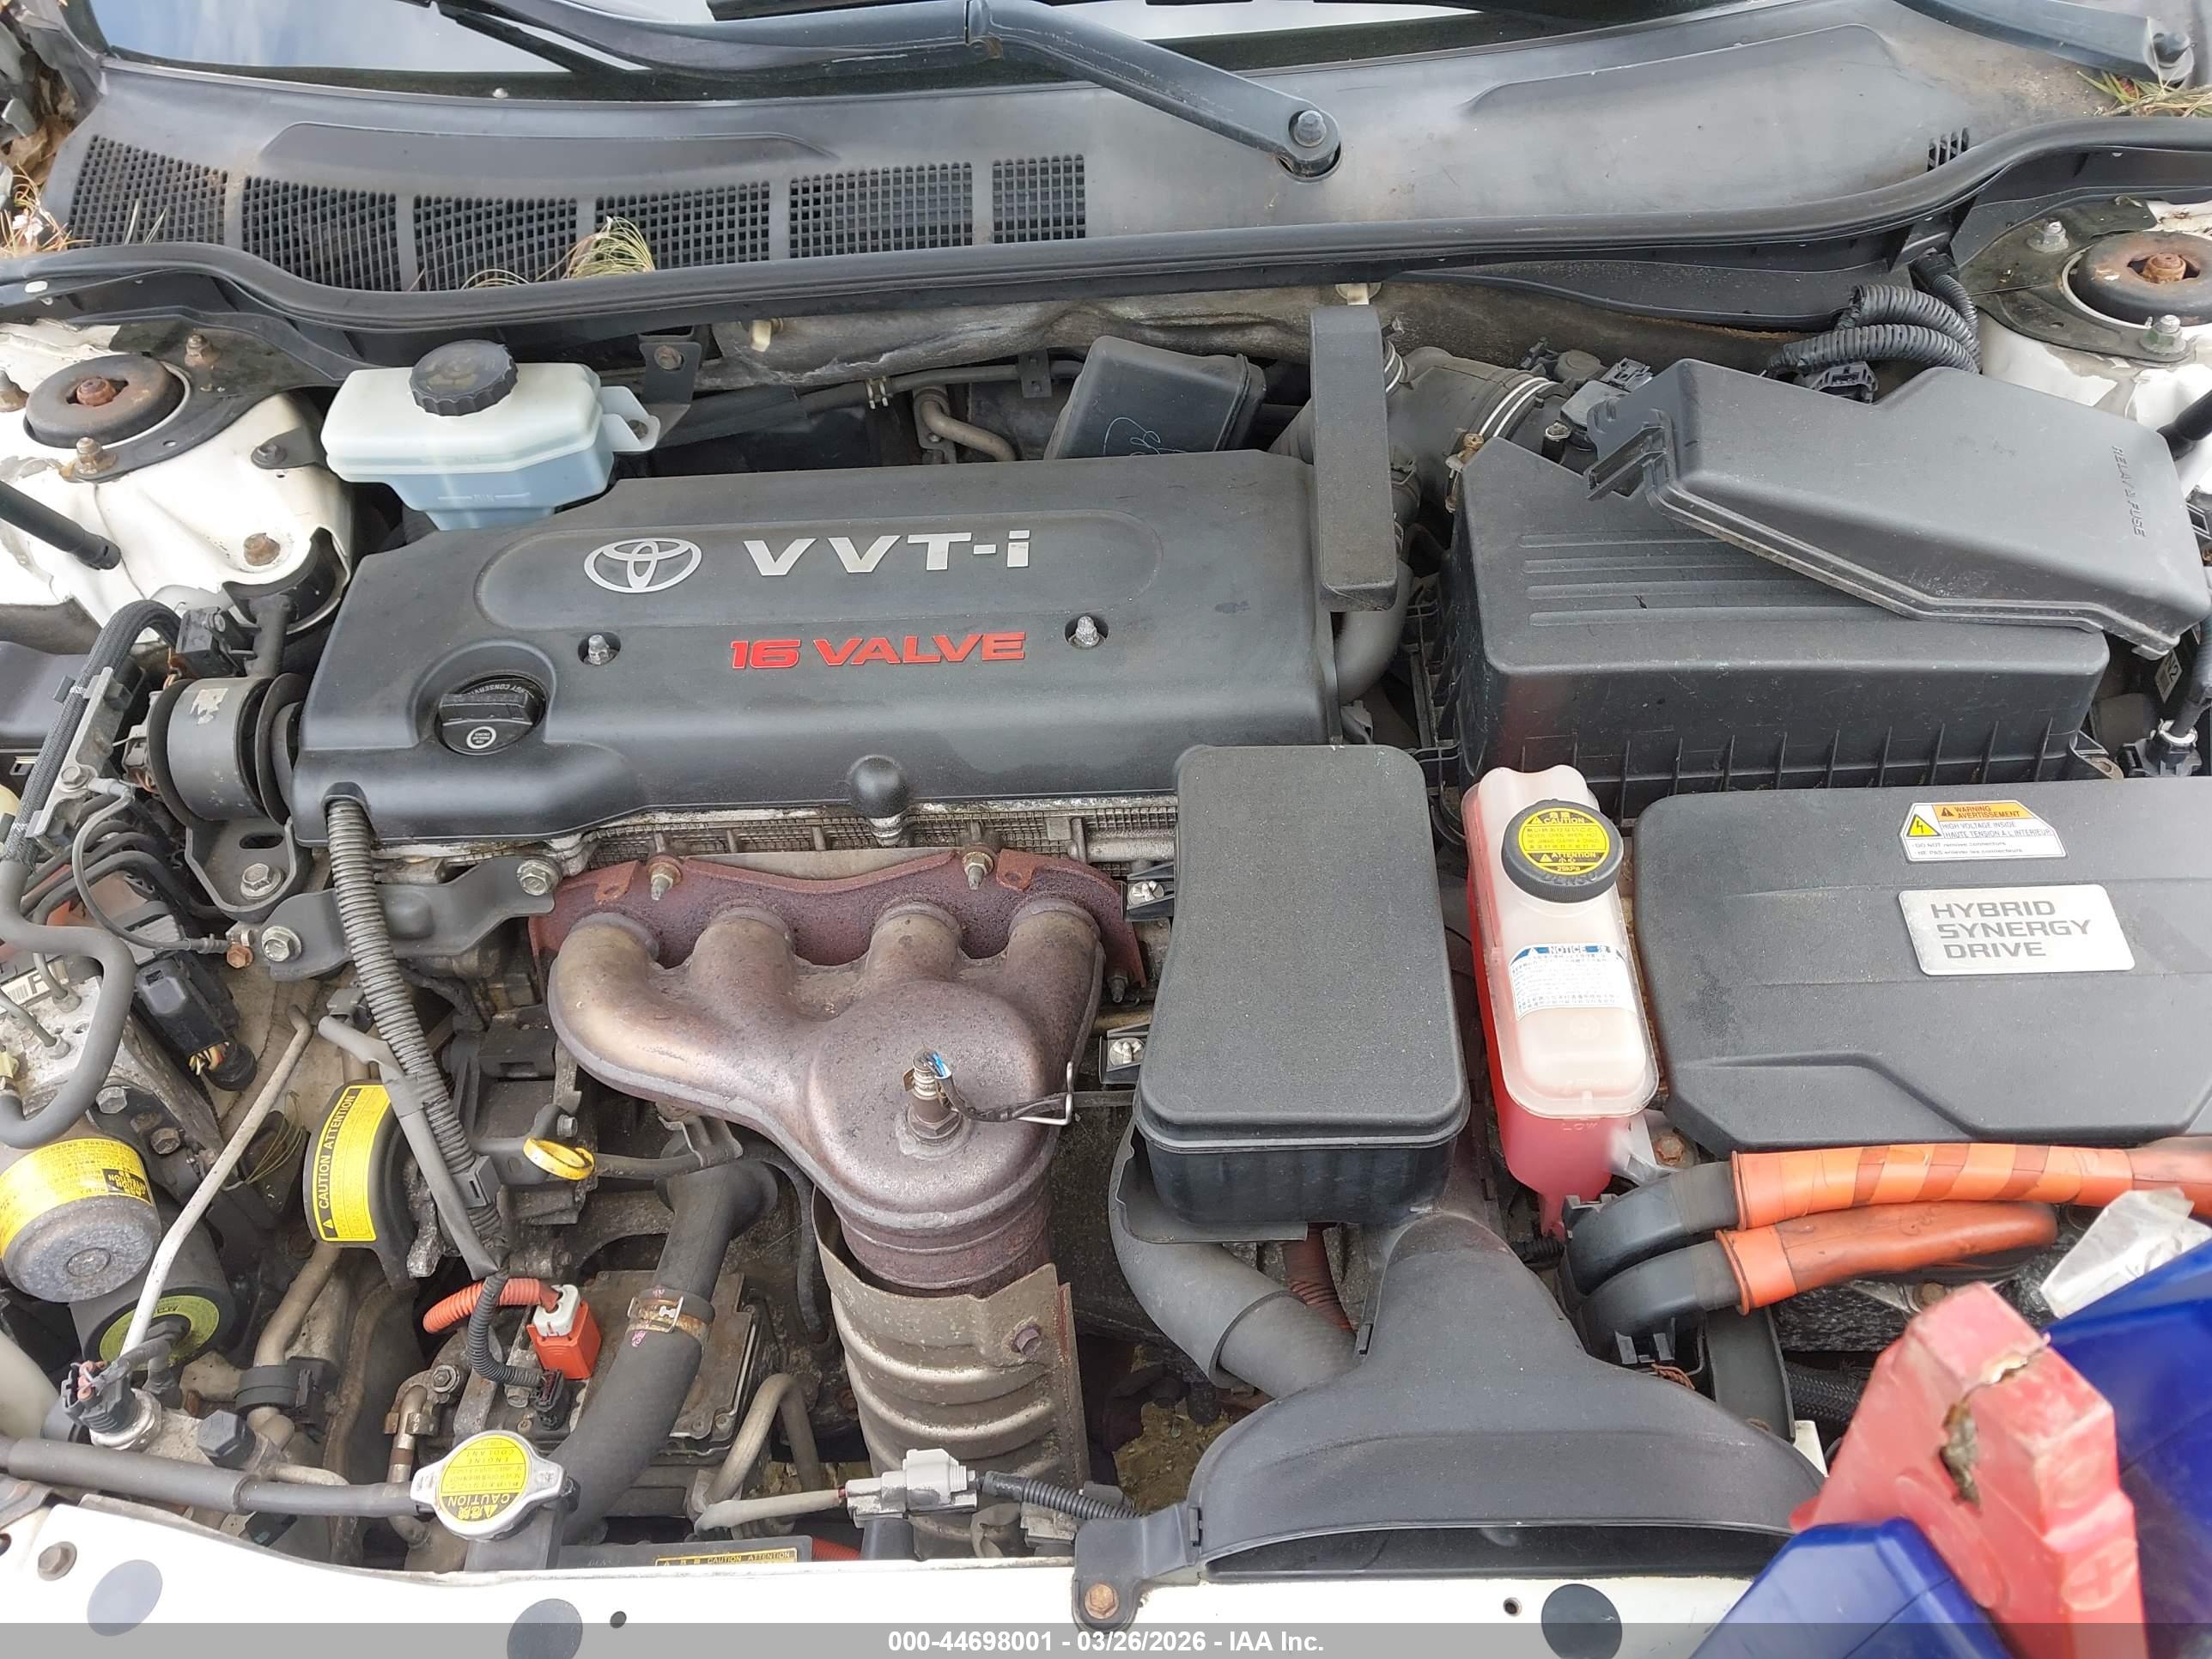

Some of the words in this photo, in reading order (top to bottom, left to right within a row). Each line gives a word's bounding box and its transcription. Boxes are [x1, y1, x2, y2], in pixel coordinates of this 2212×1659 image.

[2127, 499, 2147, 538] FUSE
[743, 530, 1030, 576] VVT-i
[730, 639, 801, 670] 16
[812, 631, 1026, 666] VALVE
[1958, 811, 2021, 819] AVERTISSEMENT
[1930, 900, 2056, 920] HYBRID
[1936, 919, 2092, 939] SYNERGY
[1943, 942, 2046, 959] DRIVE
[323, 1094, 356, 1150] ATTENTION
[1561, 1121, 1598, 1131] LOW
[318, 1155, 331, 1209] CAUTION
[447, 1493, 510, 1506] CAUTION
[707, 1555, 742, 1564] CAUTION
[747, 1551, 790, 1561] ATTENTION
